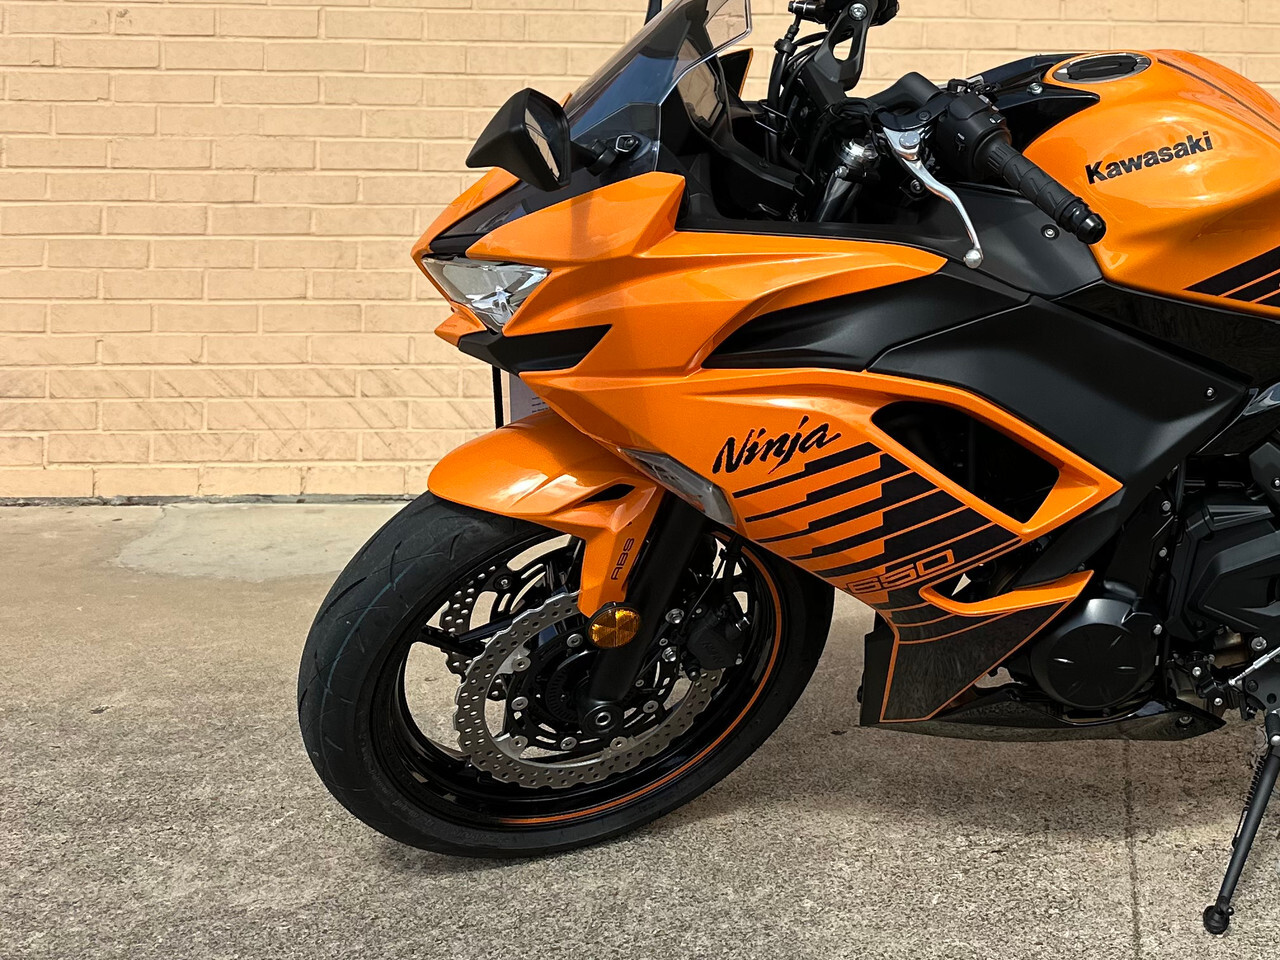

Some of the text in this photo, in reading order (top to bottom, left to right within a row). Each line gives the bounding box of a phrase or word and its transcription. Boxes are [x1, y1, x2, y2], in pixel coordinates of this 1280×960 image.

[1085, 130, 1214, 185] Kawasaki
[712, 415, 842, 475] Ninja
[610, 537, 635, 581] ABS
[846, 548, 956, 595] 650
